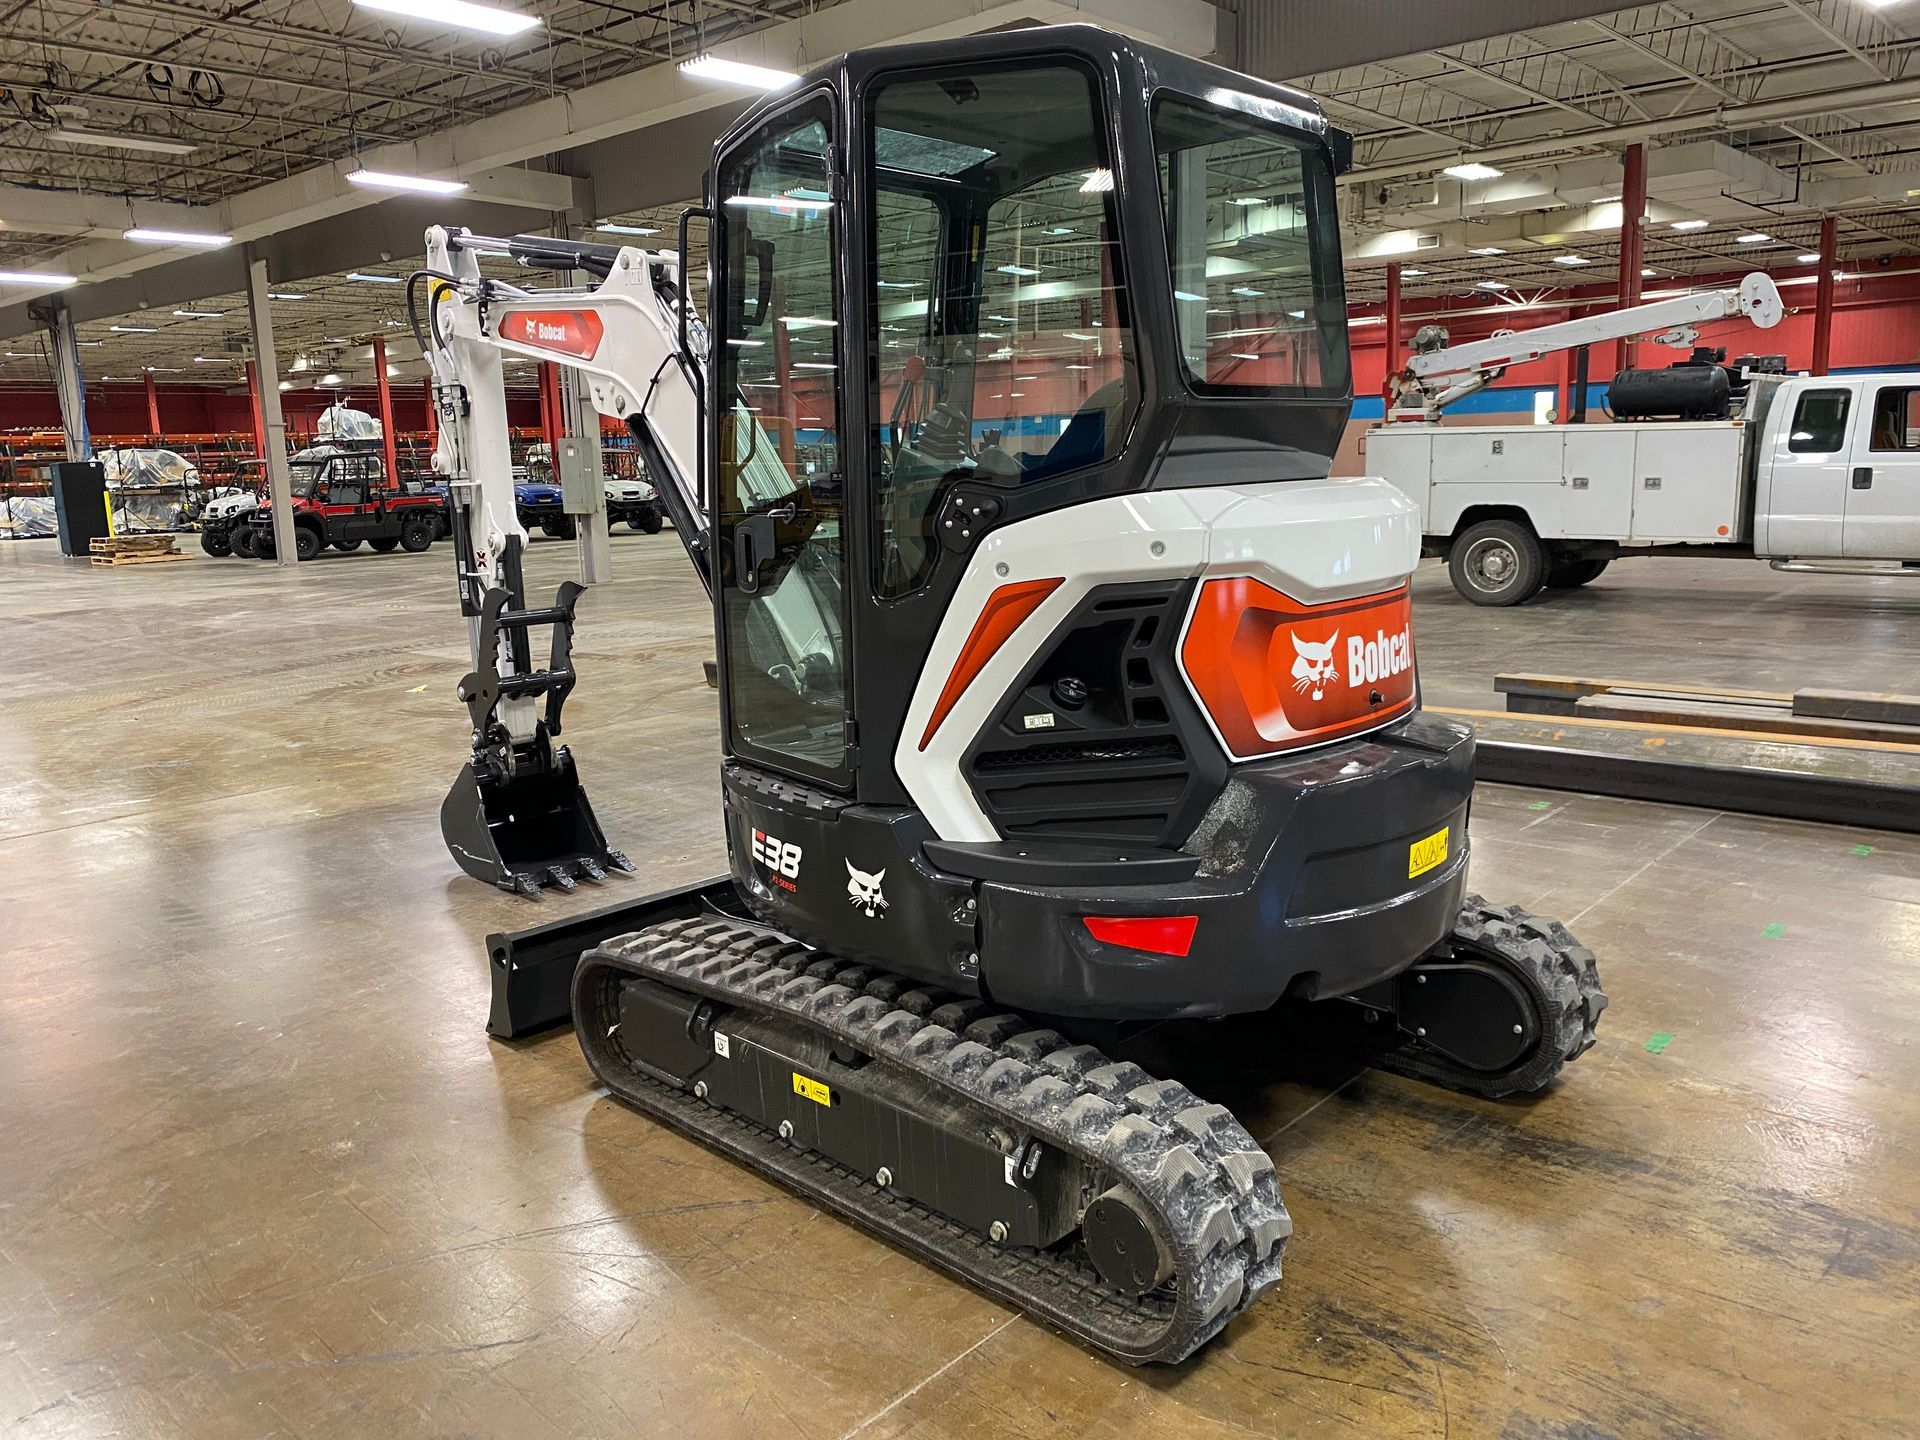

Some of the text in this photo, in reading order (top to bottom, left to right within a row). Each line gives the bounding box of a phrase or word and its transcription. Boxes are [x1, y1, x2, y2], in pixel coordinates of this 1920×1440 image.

[539, 323, 566, 341] Bobcat
[1348, 622, 1411, 688] Bobcat
[752, 827, 802, 879] E38
